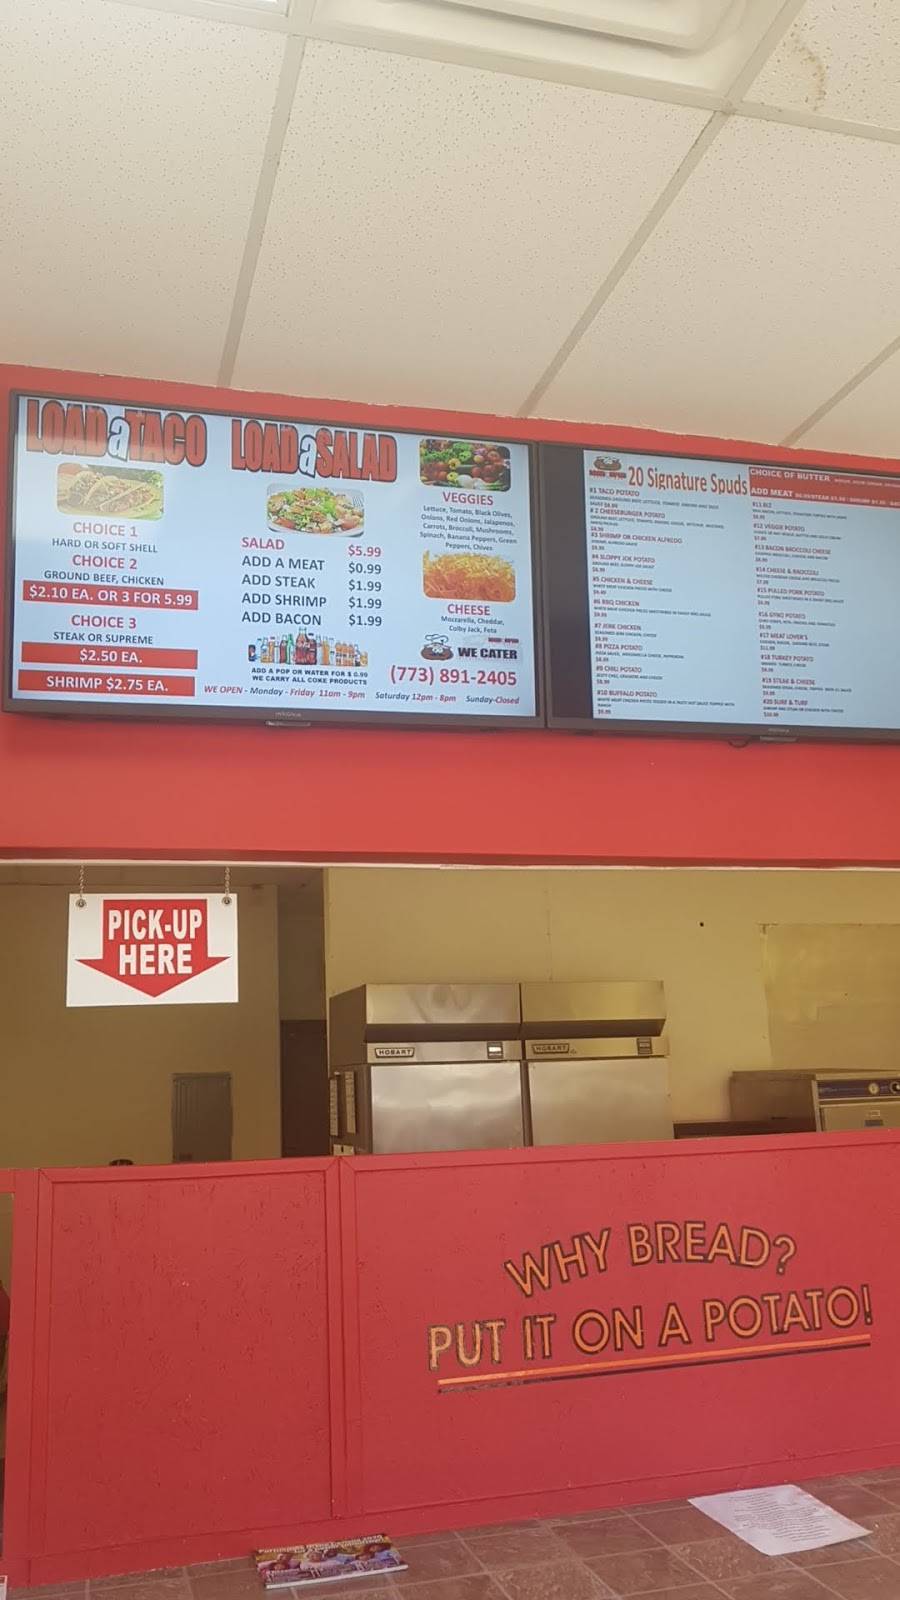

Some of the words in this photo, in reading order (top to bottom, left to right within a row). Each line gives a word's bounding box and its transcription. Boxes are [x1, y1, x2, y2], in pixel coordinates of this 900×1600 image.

[628, 466, 644, 487] 20
[647, 467, 707, 492] Signature
[710, 473, 748, 496] Spuds
[750, 468, 781, 478] CHOICE
[784, 471, 795, 479] OF
[797, 473, 831, 482] BUTTER
[442, 491, 494, 506] VEGGIES
[598, 488, 615, 496] TACO
[615, 489, 640, 497] POTATO
[751, 487, 769, 495] ADD
[770, 488, 793, 497] MEAT
[423, 505, 449, 514] Lettuce,
[449, 506, 474, 515] Tomato,
[644, 511, 665, 519] POTATO
[421, 514, 444, 522] Onions,
[459, 516, 483, 525] Onions,
[73, 521, 125, 536] CHOICE
[130, 527, 138, 537] 1
[423, 523, 447, 531] Carrots,
[449, 525, 475, 533] Broccoli,
[476, 527, 515, 536] Mushrooms,
[420, 531, 446, 540] Spinach,
[447, 533, 470, 541] Banana
[471, 535, 498, 544] Peppers,
[52, 538, 81, 549] HARD
[84, 540, 99, 550] OR
[102, 540, 126, 551] SOFT
[129, 542, 158, 553] SHELL
[241, 536, 285, 551] SALAD
[348, 544, 381, 557] $5.99
[473, 543, 493, 551] Chives
[72, 554, 125, 569] CHOICE
[126, 558, 137, 569] 2
[241, 555, 271, 568] ADD
[275, 557, 284, 568] A
[288, 558, 325, 571] MEAT
[348, 562, 382, 575] $0.99
[44, 570, 90, 581] GROUND
[92, 572, 120, 585] BEEF,
[121, 574, 164, 586] CHICKEN
[241, 574, 271, 587] ADD
[275, 576, 315, 589] STEAK
[348, 579, 382, 592] $1.99
[29, 585, 68, 600] $2.10
[71, 588, 93, 601] EA.
[99, 590, 117, 602] OR
[121, 591, 129, 603] 3
[134, 592, 161, 604] FOR
[164, 593, 192, 606] 5.99
[241, 593, 271, 605] ADD
[275, 594, 327, 608] SHRIMP
[348, 596, 382, 609] $1.99
[447, 603, 491, 616] CHEESE
[71, 614, 125, 629] CHOICE
[128, 617, 137, 629] 3
[241, 611, 271, 624] ADD
[275, 612, 321, 626] BACON
[348, 613, 382, 627] $1.99
[477, 618, 505, 626] Cheddar,
[449, 625, 466, 633] Colby
[467, 626, 482, 634] Jack,
[53, 631, 85, 642] STEAK
[87, 633, 102, 643] OR
[105, 633, 153, 644] SUPREME
[79, 649, 118, 663] $2.50
[121, 651, 143, 663] EA.
[458, 647, 478, 658] WE
[480, 648, 517, 660] CATER
[390, 664, 434, 686] (773)
[439, 668, 517, 686] 891-2405
[46, 675, 102, 690] SHRIMP
[106, 676, 143, 691] $2.75
[147, 680, 168, 692] EA.
[204, 685, 220, 693] WE
[221, 686, 243, 694] OPEN
[250, 687, 283, 696] Monday
[290, 688, 315, 697] Friday
[319, 689, 341, 697] 11am
[347, 691, 365, 699] 9pm
[376, 691, 410, 701] Saturday
[412, 692, 433, 702] 12pm
[440, 694, 457, 702] 8pm
[108, 909, 203, 940] PICK-UP
[119, 943, 193, 976] HERE
[378, 1049, 412, 1057] HOBART
[534, 1044, 567, 1053] HOBART
[504, 1228, 611, 1298] WHY
[628, 1221, 797, 1276] BREAD?
[428, 1319, 505, 1371] PUT
[522, 1313, 557, 1361] IT
[571, 1306, 644, 1354] ON
[658, 1302, 691, 1348] A
[703, 1285, 874, 1342] POTATO!
